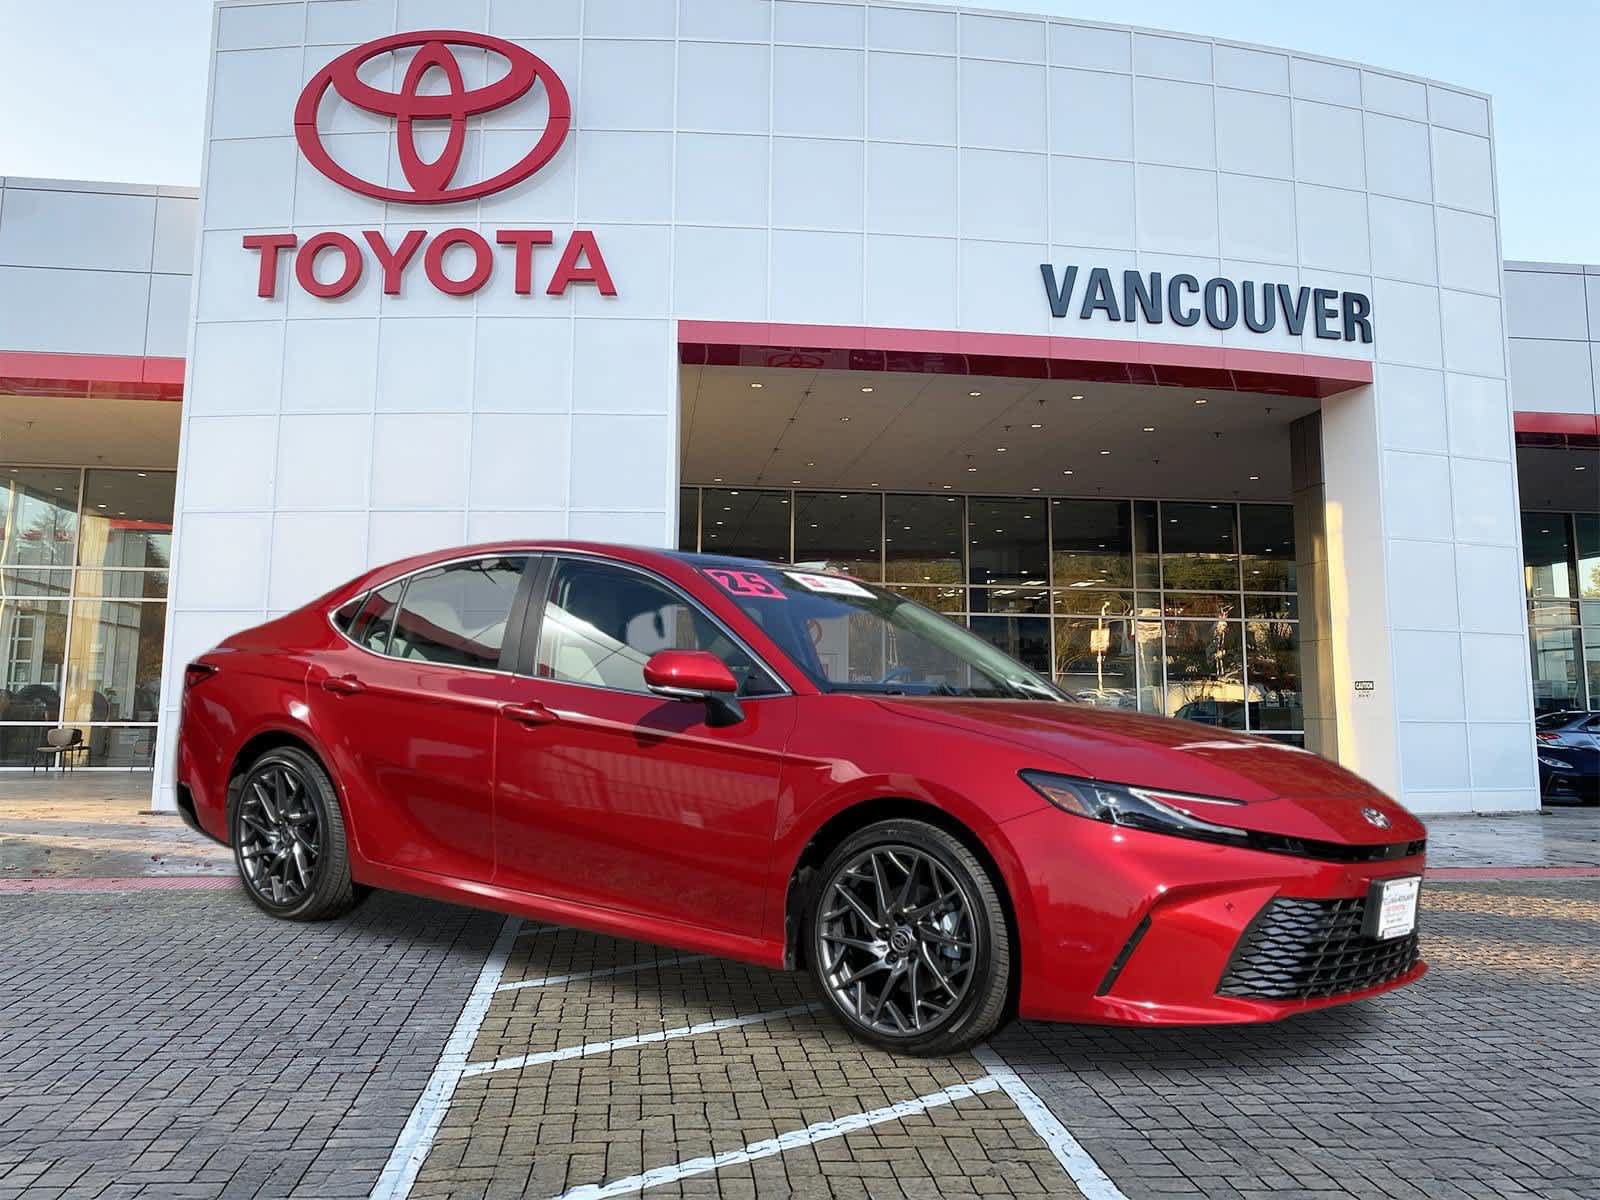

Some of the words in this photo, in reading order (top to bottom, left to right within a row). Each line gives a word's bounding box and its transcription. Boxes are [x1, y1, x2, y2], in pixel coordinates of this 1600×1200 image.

[243, 228, 618, 298] TOYOTA
[1040, 264, 1374, 344] VANCOUVER
[711, 571, 774, 594] 25
